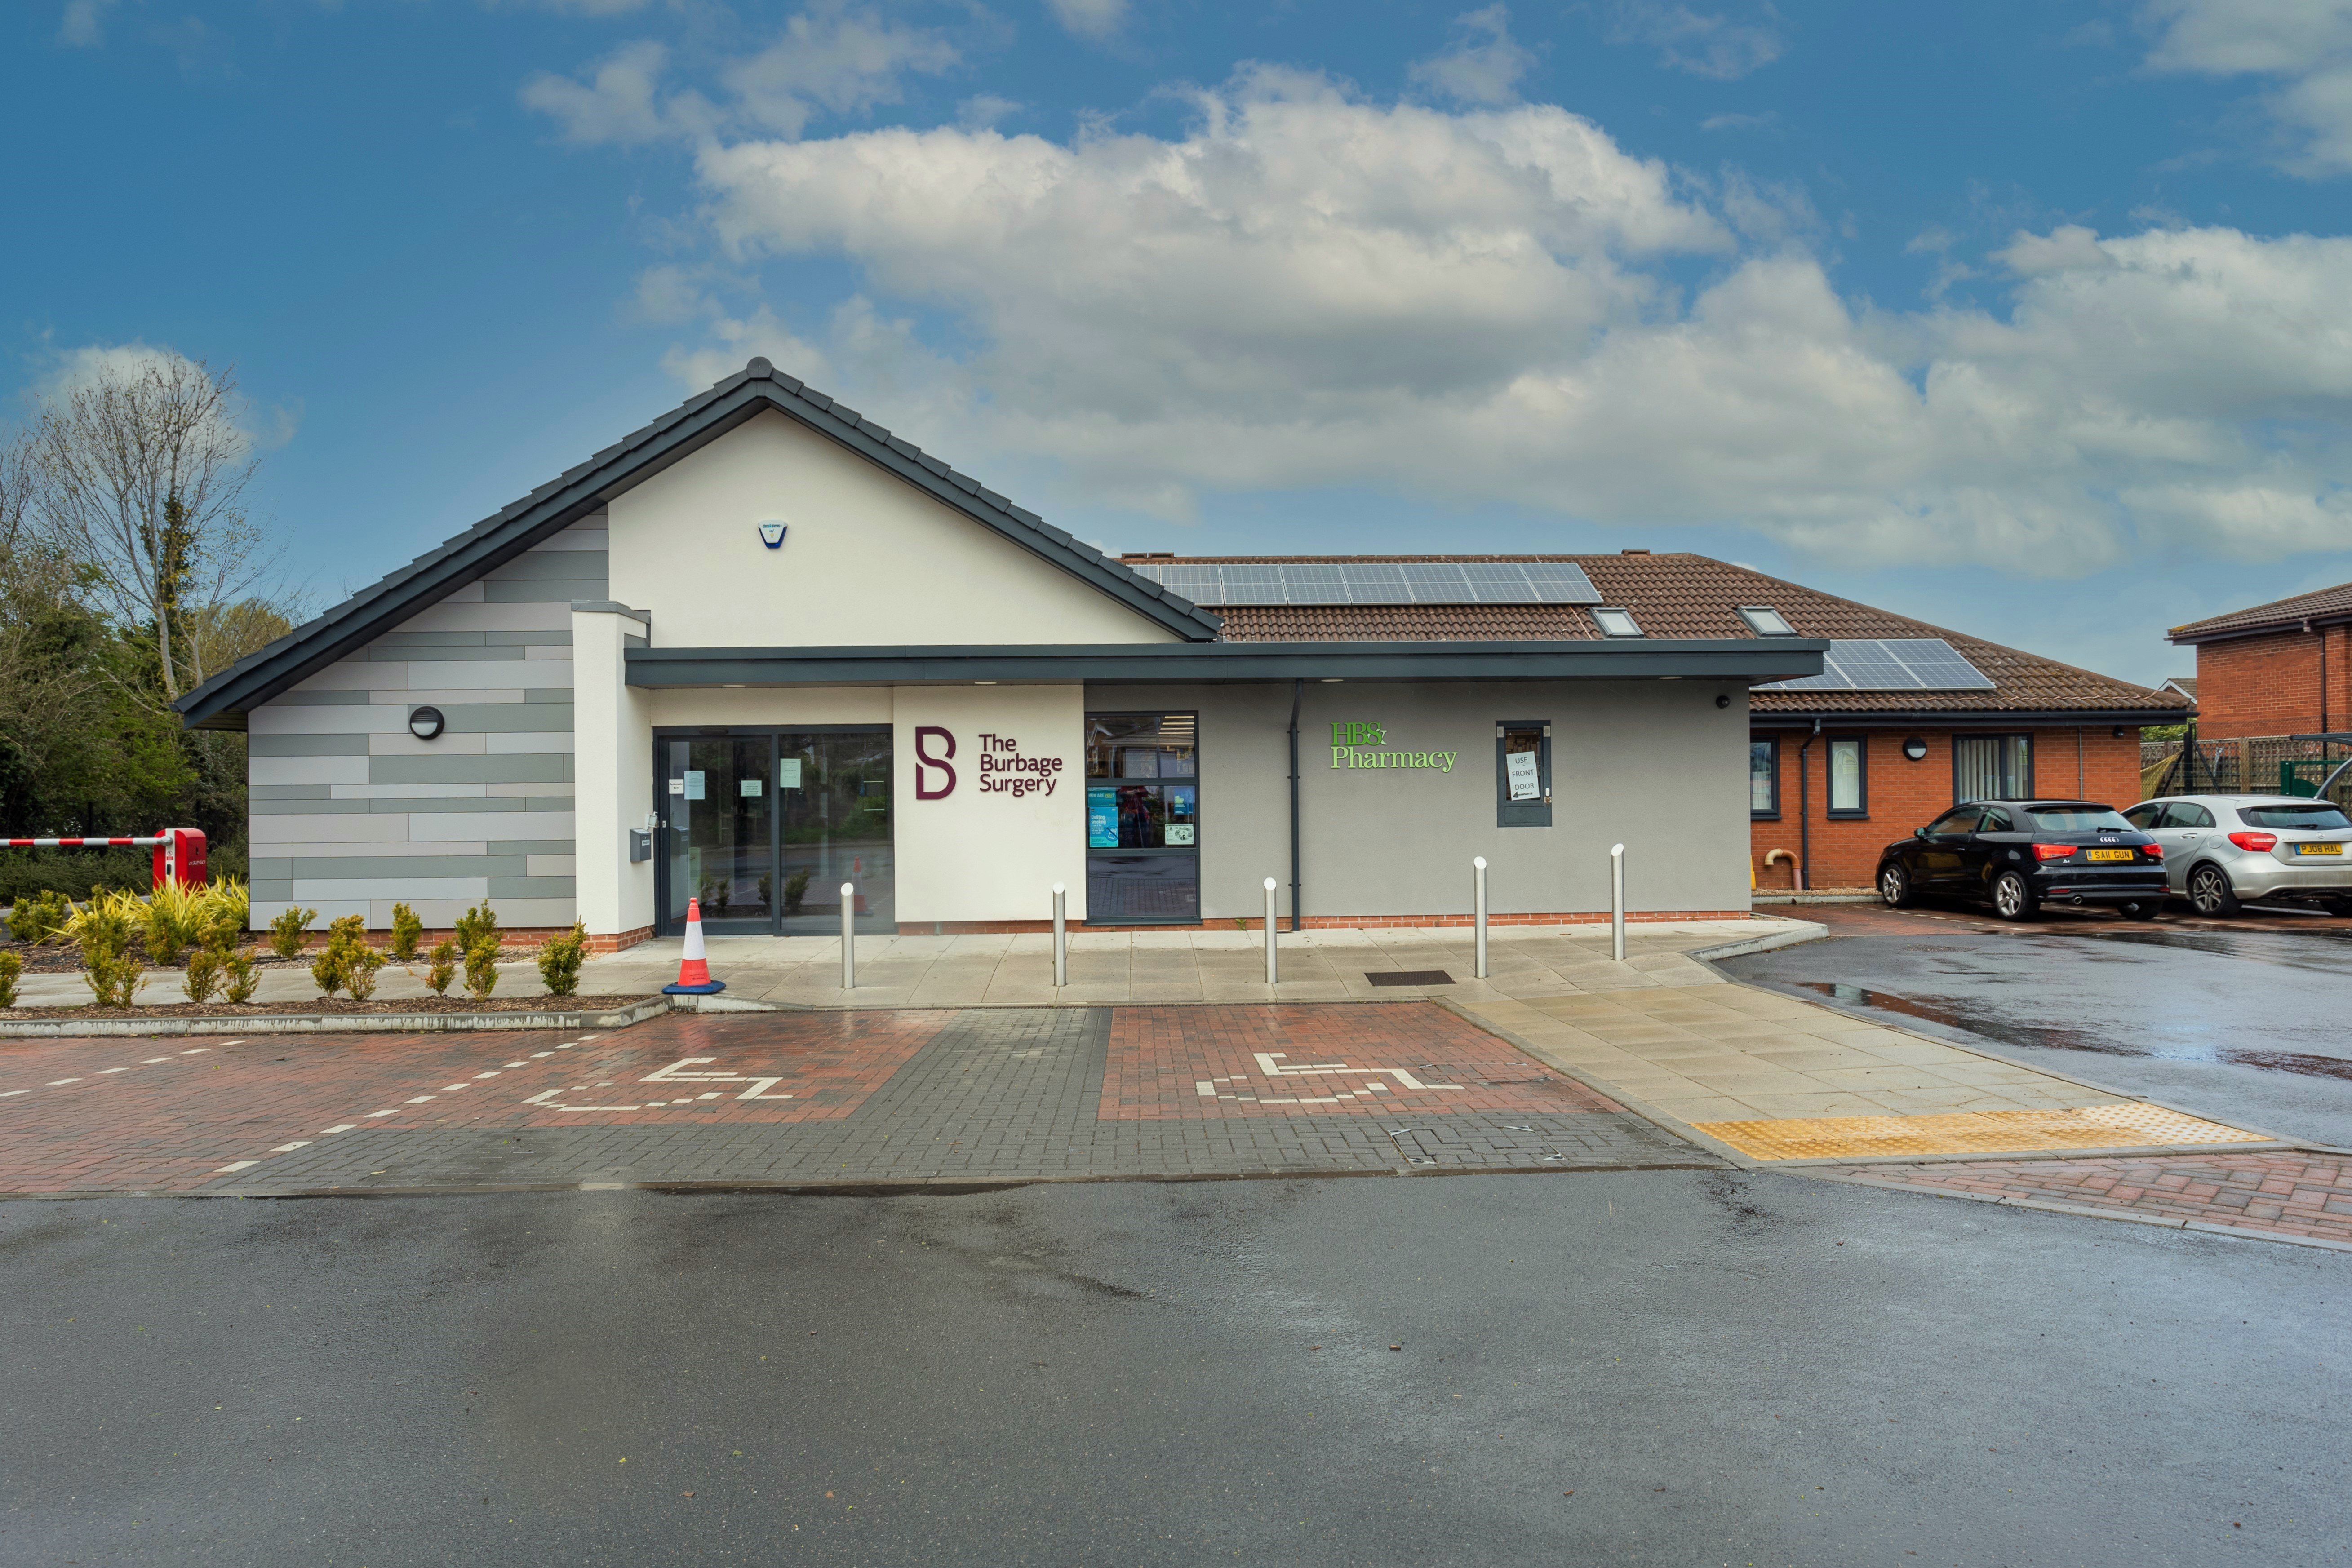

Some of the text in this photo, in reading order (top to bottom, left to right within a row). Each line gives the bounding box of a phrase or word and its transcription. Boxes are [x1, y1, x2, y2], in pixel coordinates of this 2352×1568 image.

[978, 733, 1016, 752] The
[981, 753, 1063, 777] Burbage
[1331, 747, 1458, 772] Pharmacy
[980, 773, 1057, 797] Surgery
[1512, 769, 1534, 777] FRONT
